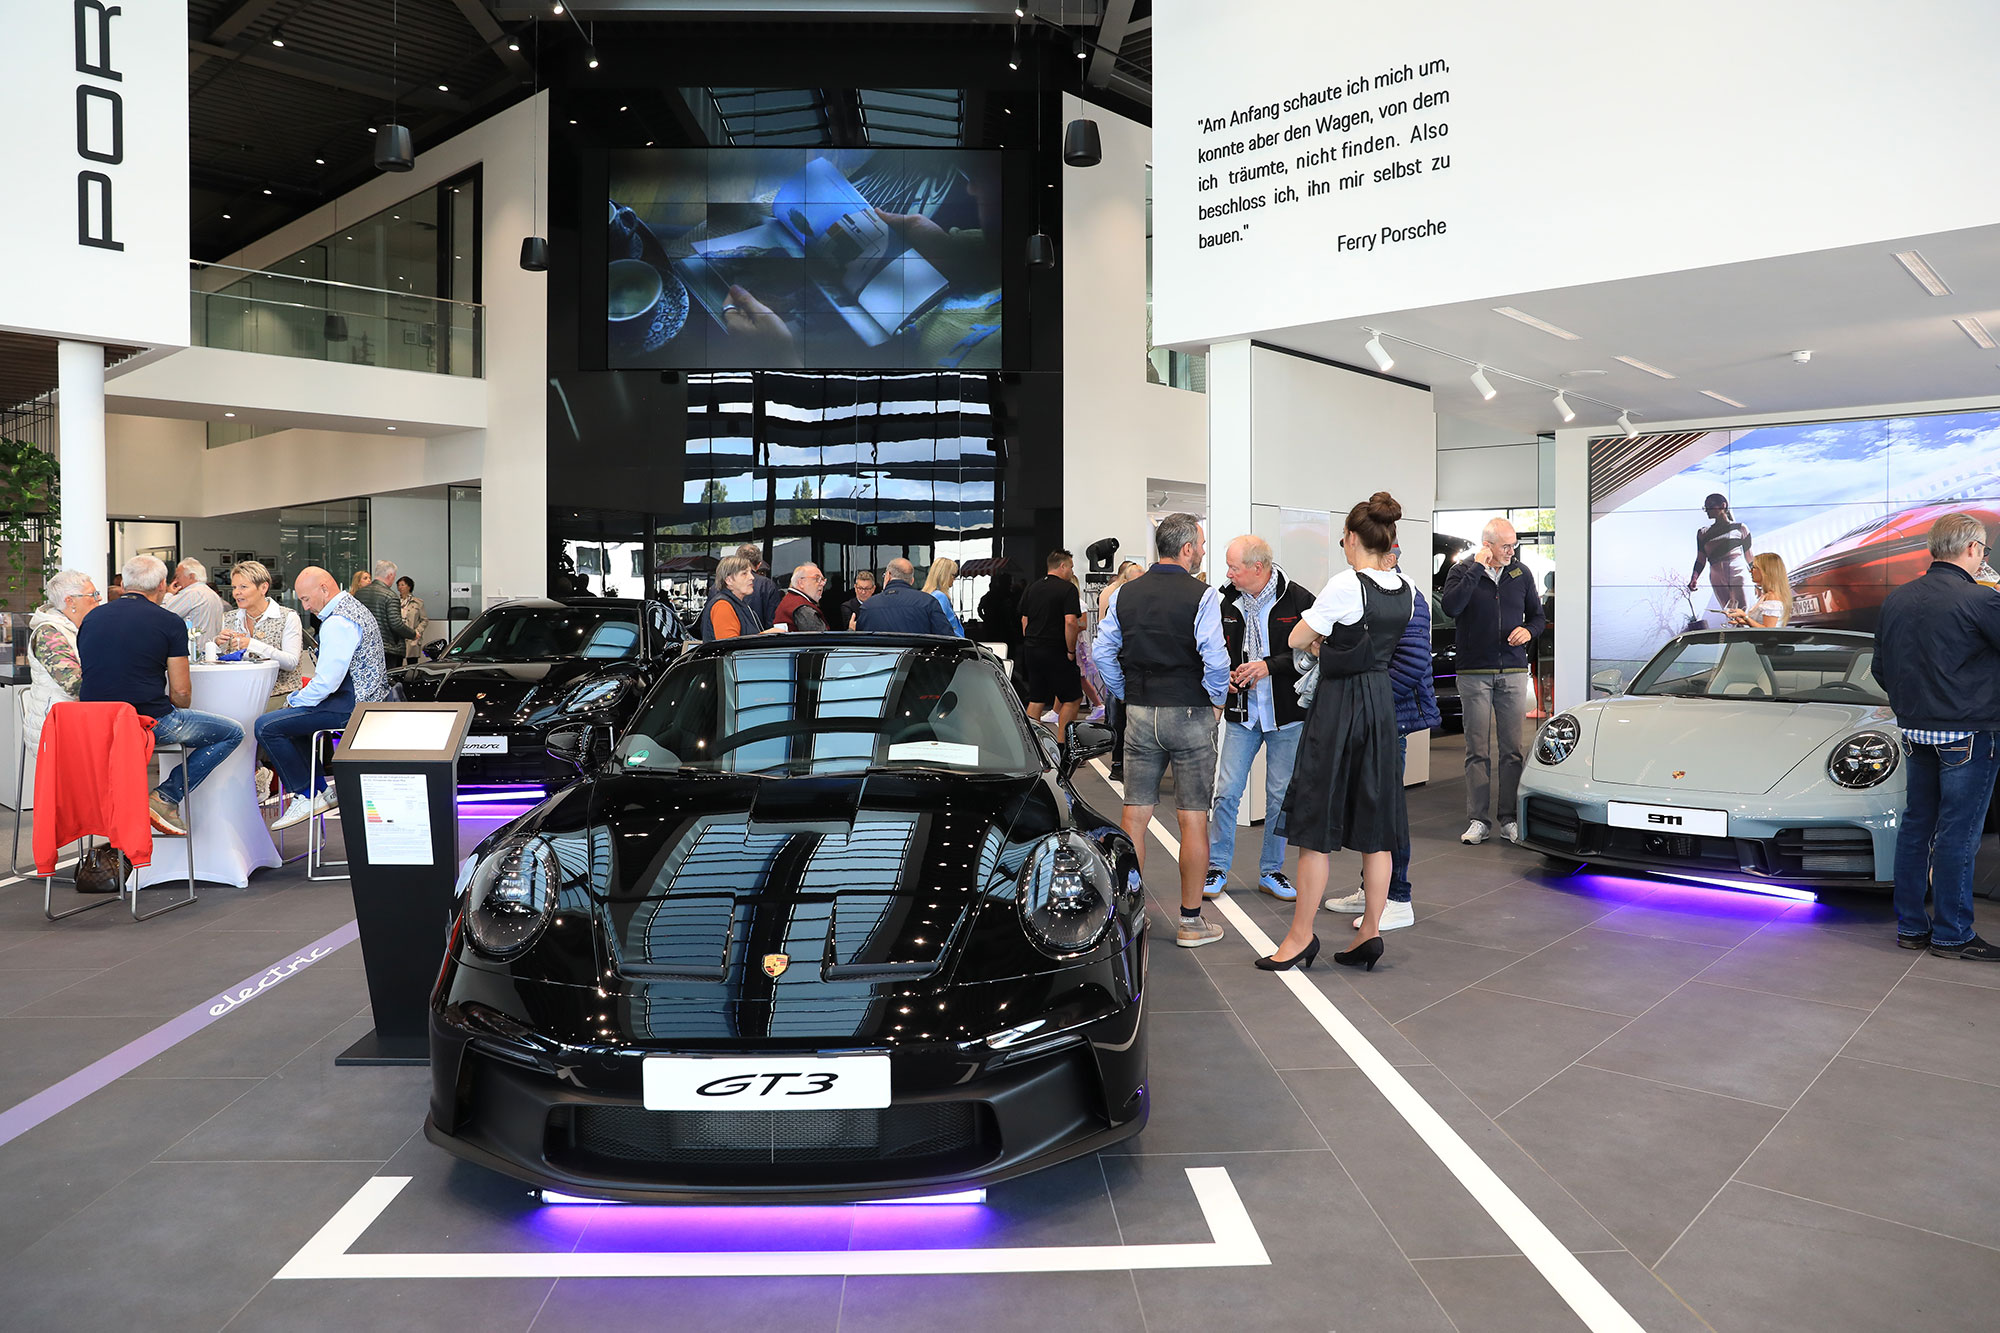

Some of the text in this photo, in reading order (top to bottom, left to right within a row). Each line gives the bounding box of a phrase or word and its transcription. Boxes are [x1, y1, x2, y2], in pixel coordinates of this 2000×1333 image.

[74, 0, 125, 253] POR
[1197, 58, 1450, 135] "Am Anfang schaute ich mich um,
[1198, 90, 1450, 164] konnte aber den Wagen, von dem
[1198, 122, 1449, 192] ich träumte, nicht finden. Also
[1198, 154, 1451, 221] beschloss ich, ihn mir selbst zu
[1198, 223, 1249, 250] bauen."
[1337, 218, 1447, 253] Ferry Porsche
[1647, 813, 1683, 826] 911
[208, 946, 334, 1017] electric
[695, 1072, 840, 1097] GT3
